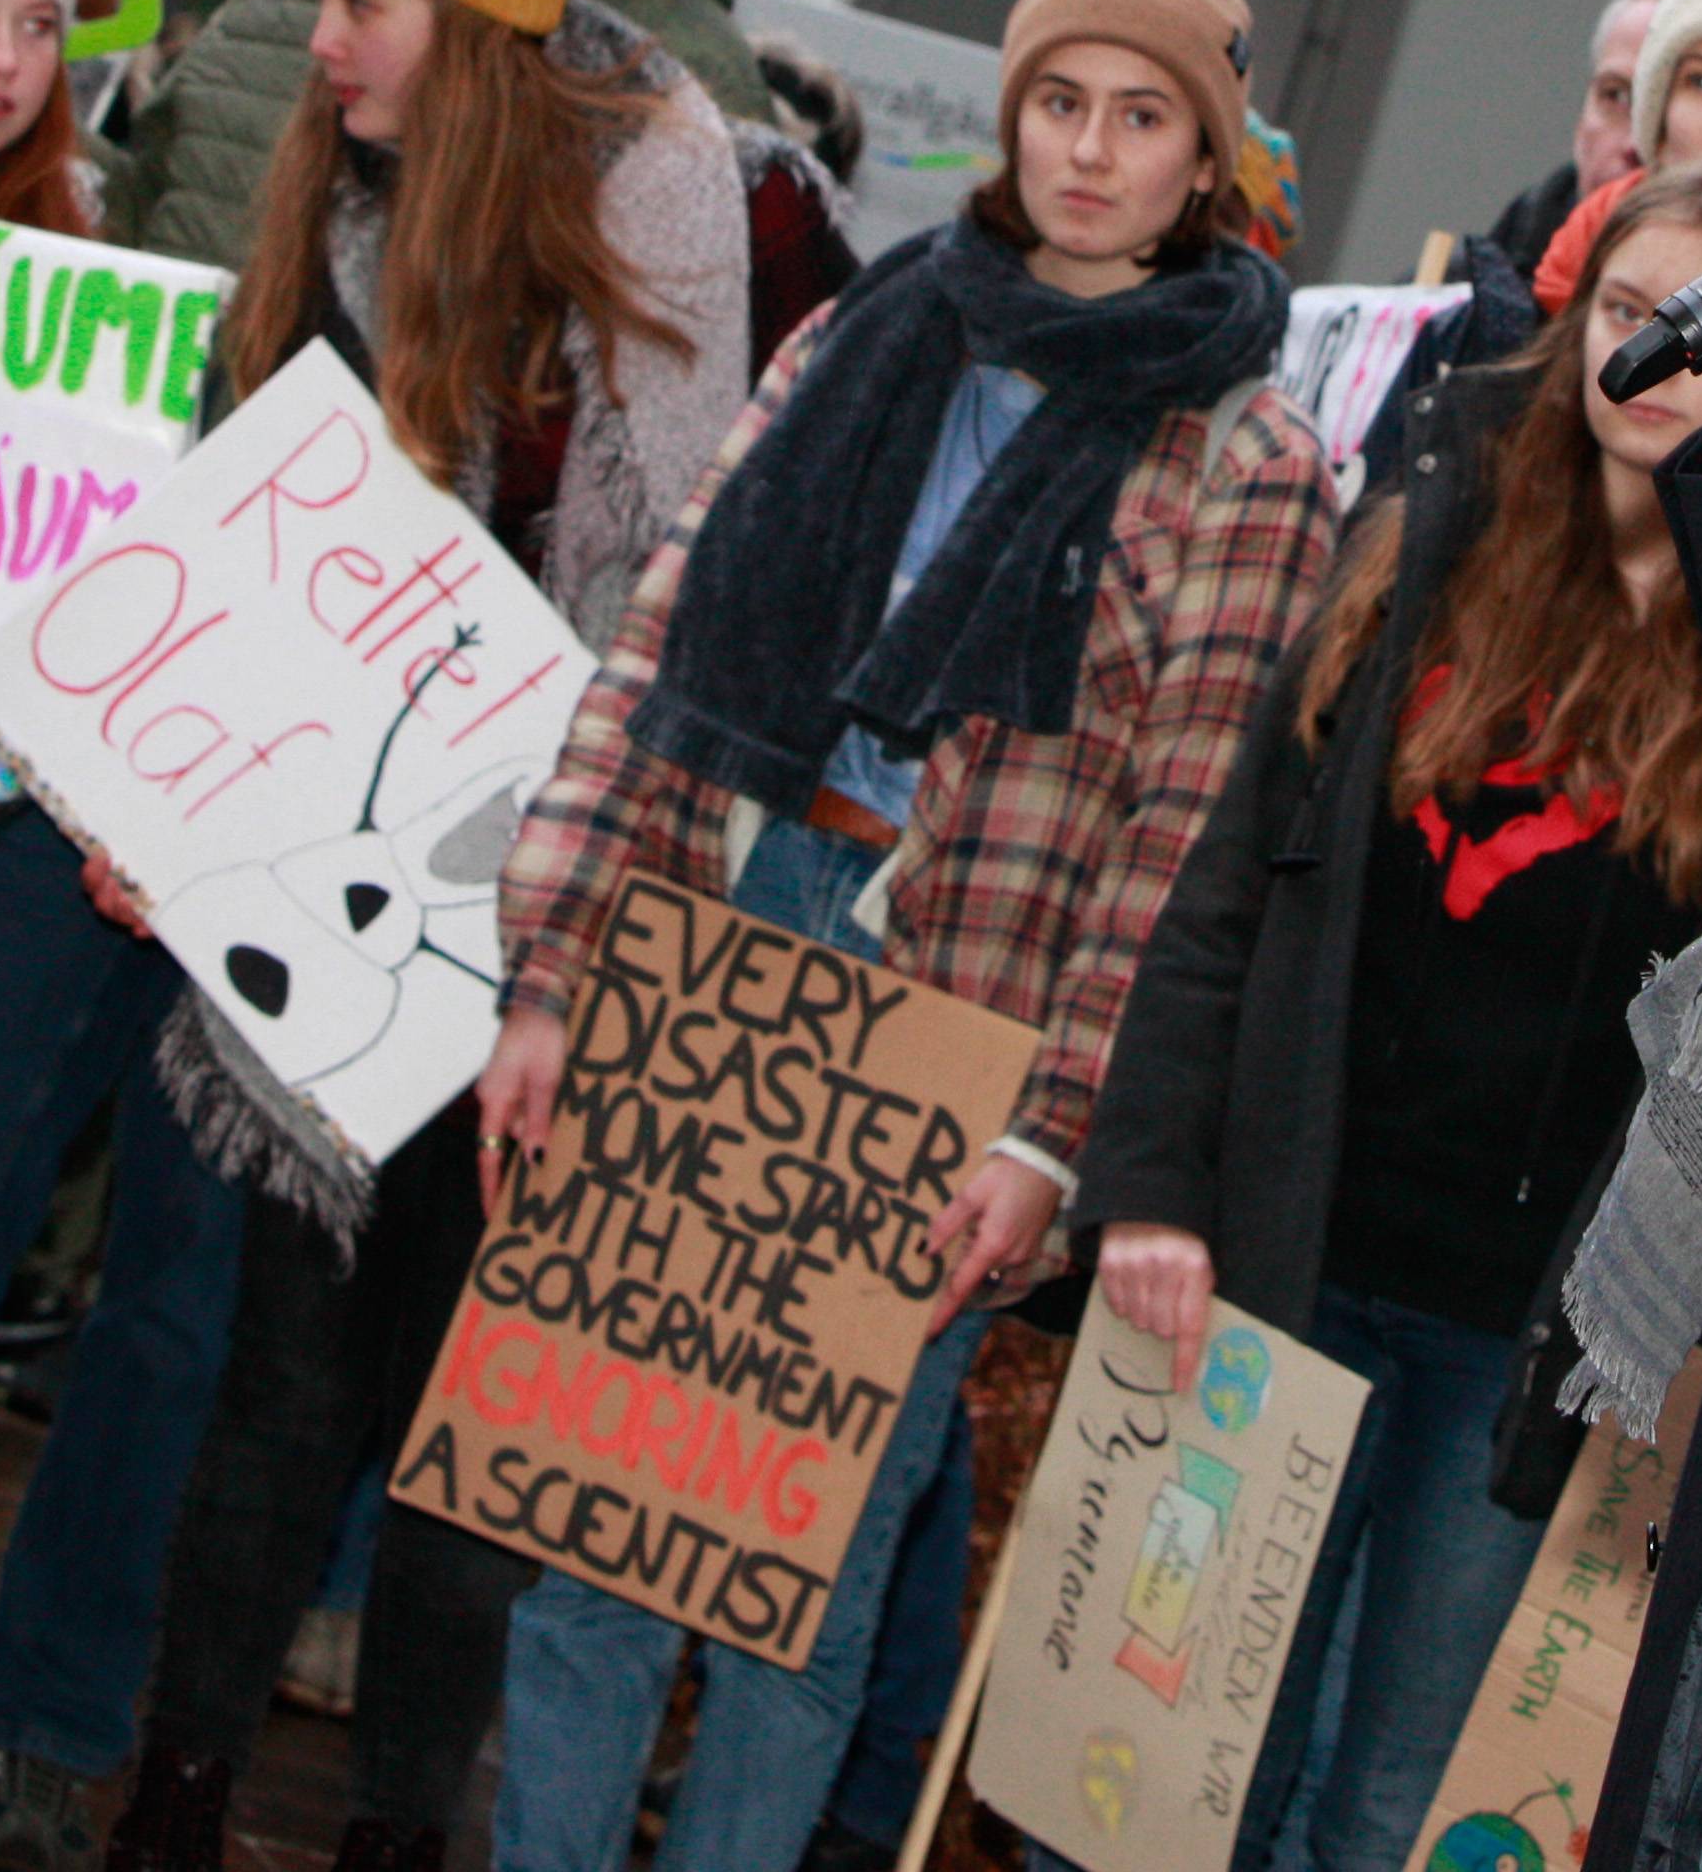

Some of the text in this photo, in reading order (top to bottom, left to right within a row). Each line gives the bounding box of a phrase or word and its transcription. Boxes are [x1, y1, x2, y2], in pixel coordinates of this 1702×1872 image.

[31, 541, 334, 823] Olaf
[600, 879, 911, 1068] EVERY
[566, 968, 968, 1212] DISASTER
[472, 1233, 900, 1458] GOVERNMENT
[507, 1156, 835, 1348] WITH THE
[439, 1302, 829, 1540] IGNORING
[398, 1421, 829, 1653] A SCIENTIST
[1223, 1430, 1335, 1723] BEENDEN
[1195, 1736, 1247, 1820] WIR
[1510, 1609, 1595, 1723] EARTH
